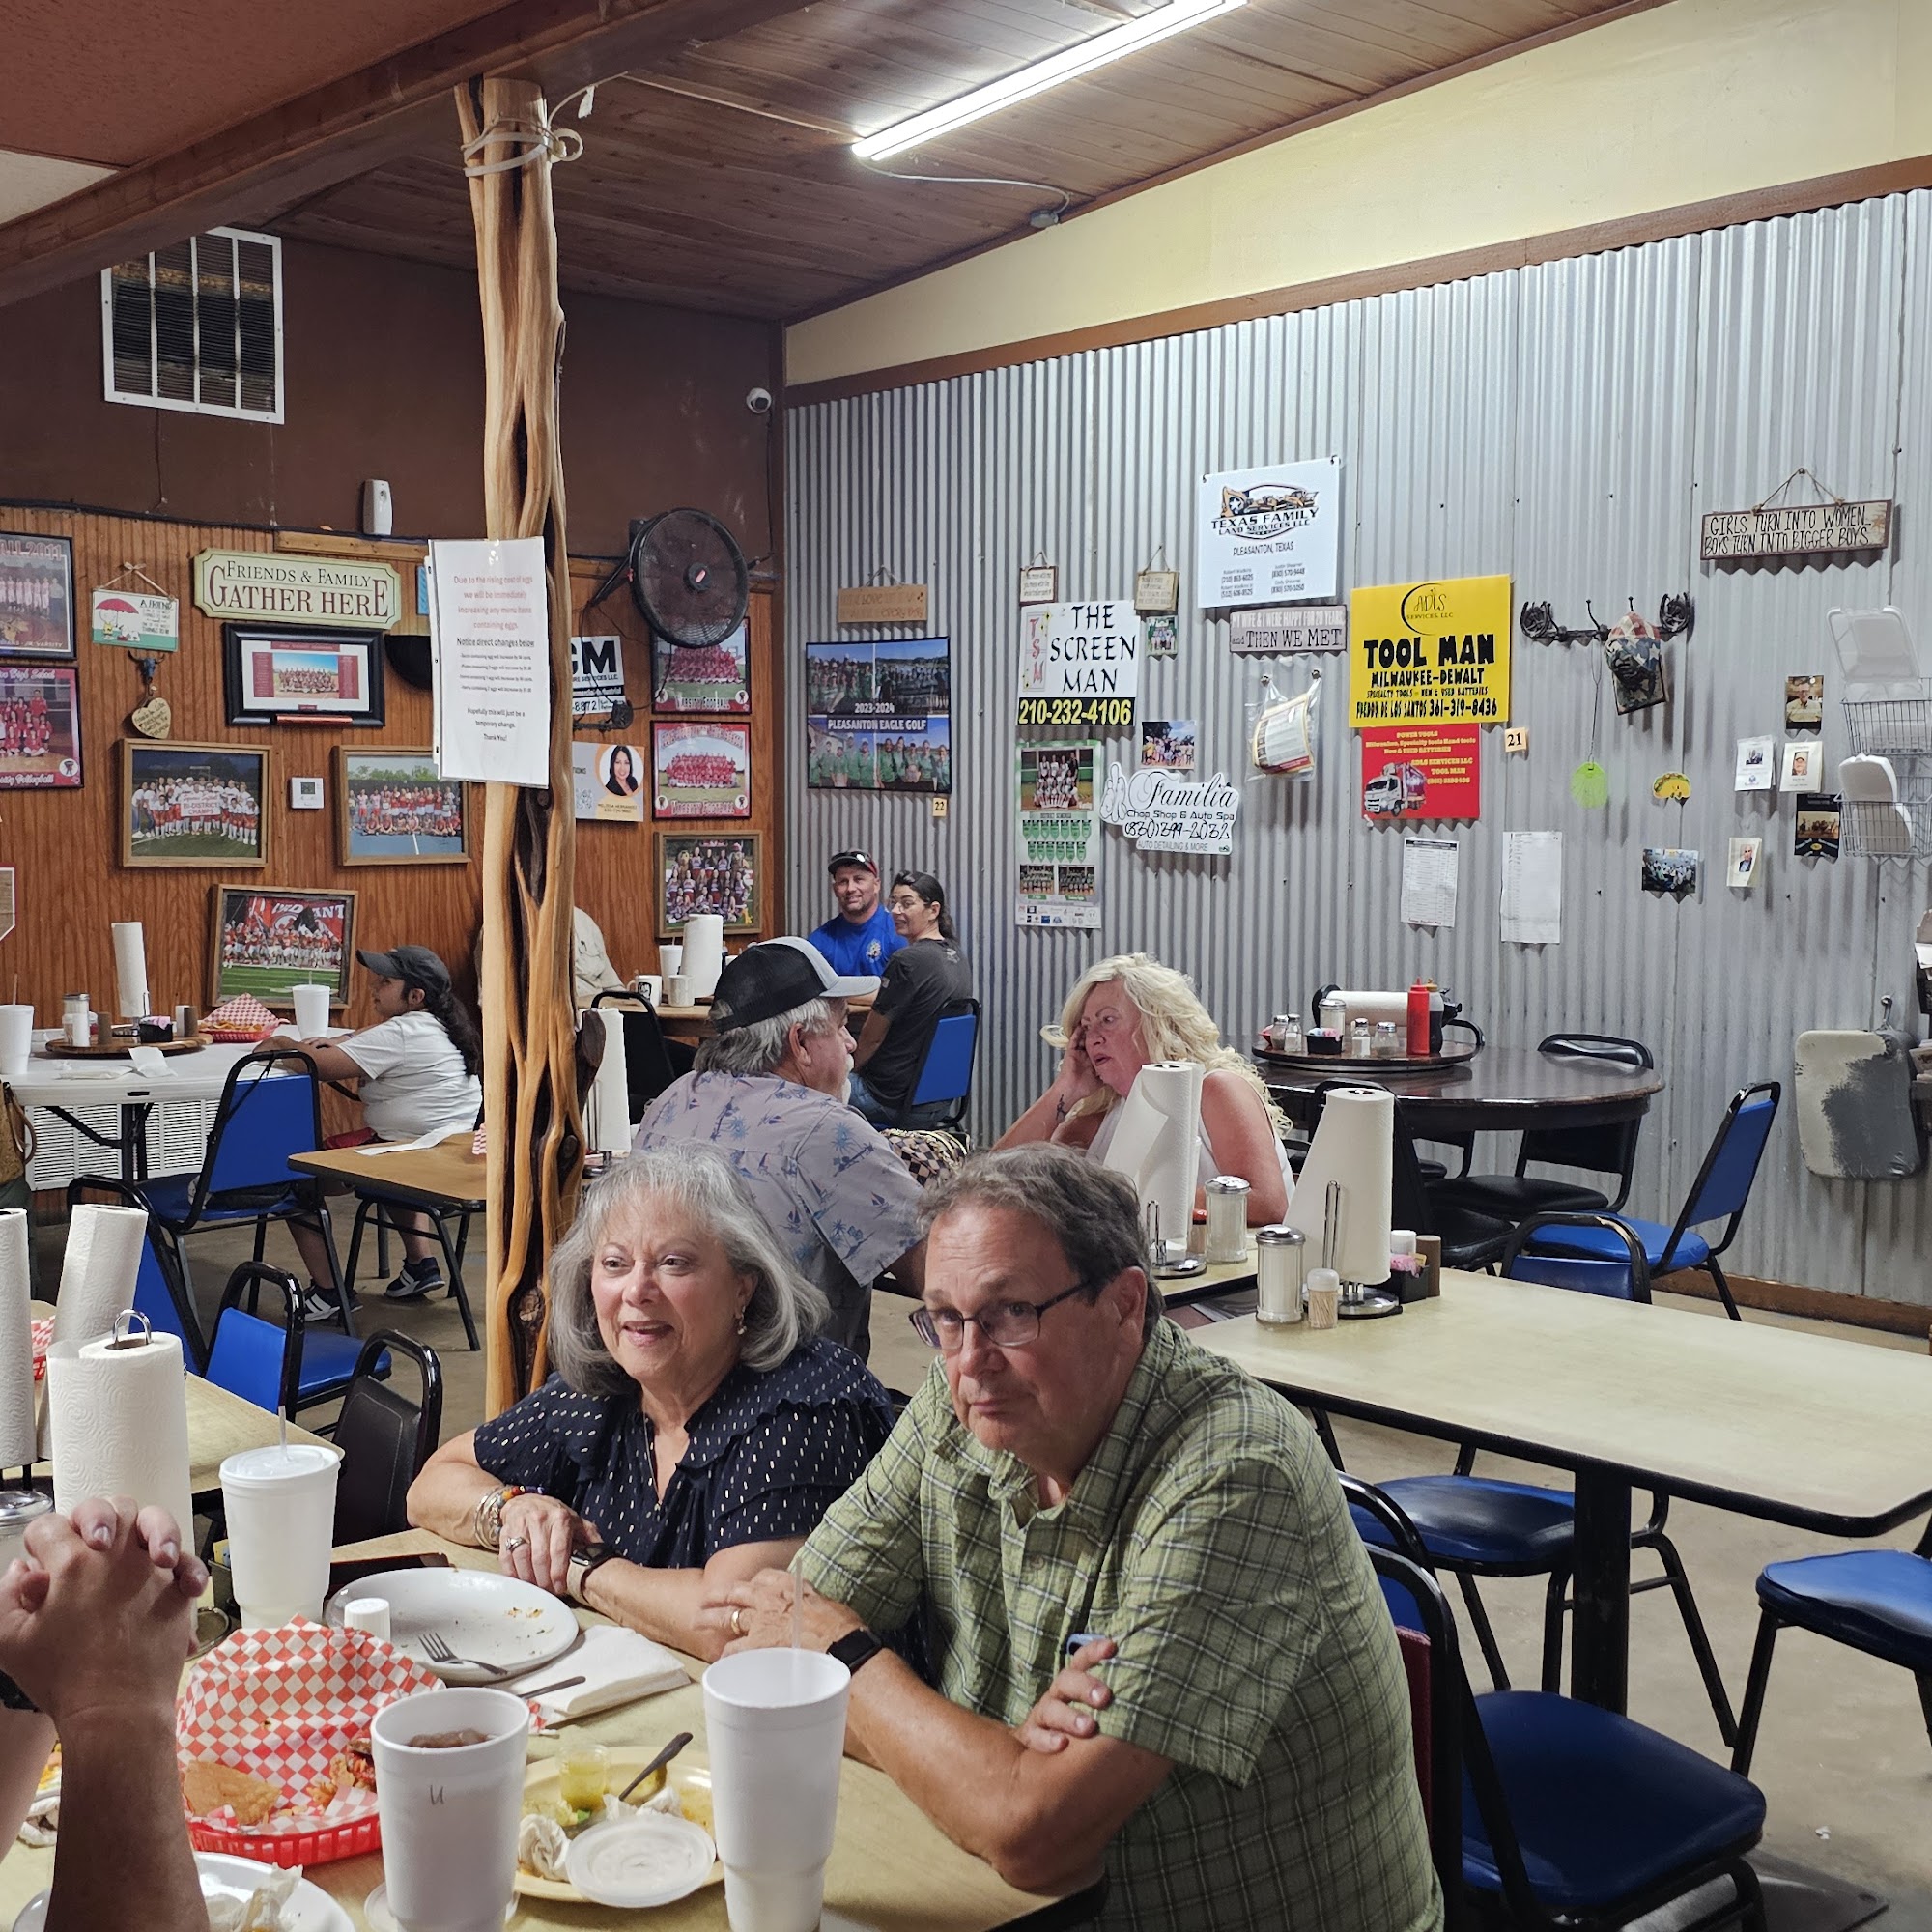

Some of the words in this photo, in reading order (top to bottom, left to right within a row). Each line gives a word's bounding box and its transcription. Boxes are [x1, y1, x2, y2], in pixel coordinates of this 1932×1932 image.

[1211, 515, 1257, 530] TEXAS
[1263, 507, 1319, 521] FAMILY
[1219, 526, 1243, 535] LAND
[1247, 522, 1290, 532] SERVICES
[1710, 515, 1747, 536] GIRLS
[1755, 511, 1781, 532] TURN
[1784, 509, 1816, 531] INTO
[1275, 541, 1293, 552] TEXAS
[1705, 534, 1730, 556] BOYS
[1732, 533, 1755, 554] TURN
[1760, 532, 1788, 554] INTO
[1792, 529, 1833, 550] BIGGER
[226, 560, 296, 582] FRIENDS
[300, 570, 312, 583] &
[318, 568, 371, 587] FAMILY
[209, 565, 313, 613] GATHER
[320, 579, 388, 617] HERE
[1071, 604, 1115, 629] THE
[457, 638, 475, 646] Notice
[476, 638, 493, 646] direct
[495, 639, 518, 648] changes
[519, 639, 535, 647] below
[1050, 635, 1136, 662] SCREEN
[1246, 631, 1278, 648] THEN
[1283, 629, 1303, 647] WE
[1363, 637, 1427, 668] TOOL
[1438, 634, 1494, 667] MAN
[1063, 668, 1118, 693] MAN
[1371, 668, 1484, 688] MILWAUKEE-DEWALT
[855, 702, 895, 714] 2023-2024
[1018, 699, 1132, 724] 210-232-4106
[1429, 697, 1497, 717] 361-319-8436
[828, 719, 878, 730] PLEASANTON
[880, 719, 904, 730] EAGLE
[905, 719, 926, 730] GOLF
[1507, 732, 1522, 746] 21
[1128, 771, 1237, 810] Familia
[934, 802, 945, 811] 22
[1126, 810, 1151, 820] Chop
[1152, 810, 1177, 822] Shop
[1190, 811, 1212, 820] Auto
[1216, 811, 1235, 823] Spa
[1138, 840, 1153, 849] AUTO
[1190, 842, 1208, 851] MORE
